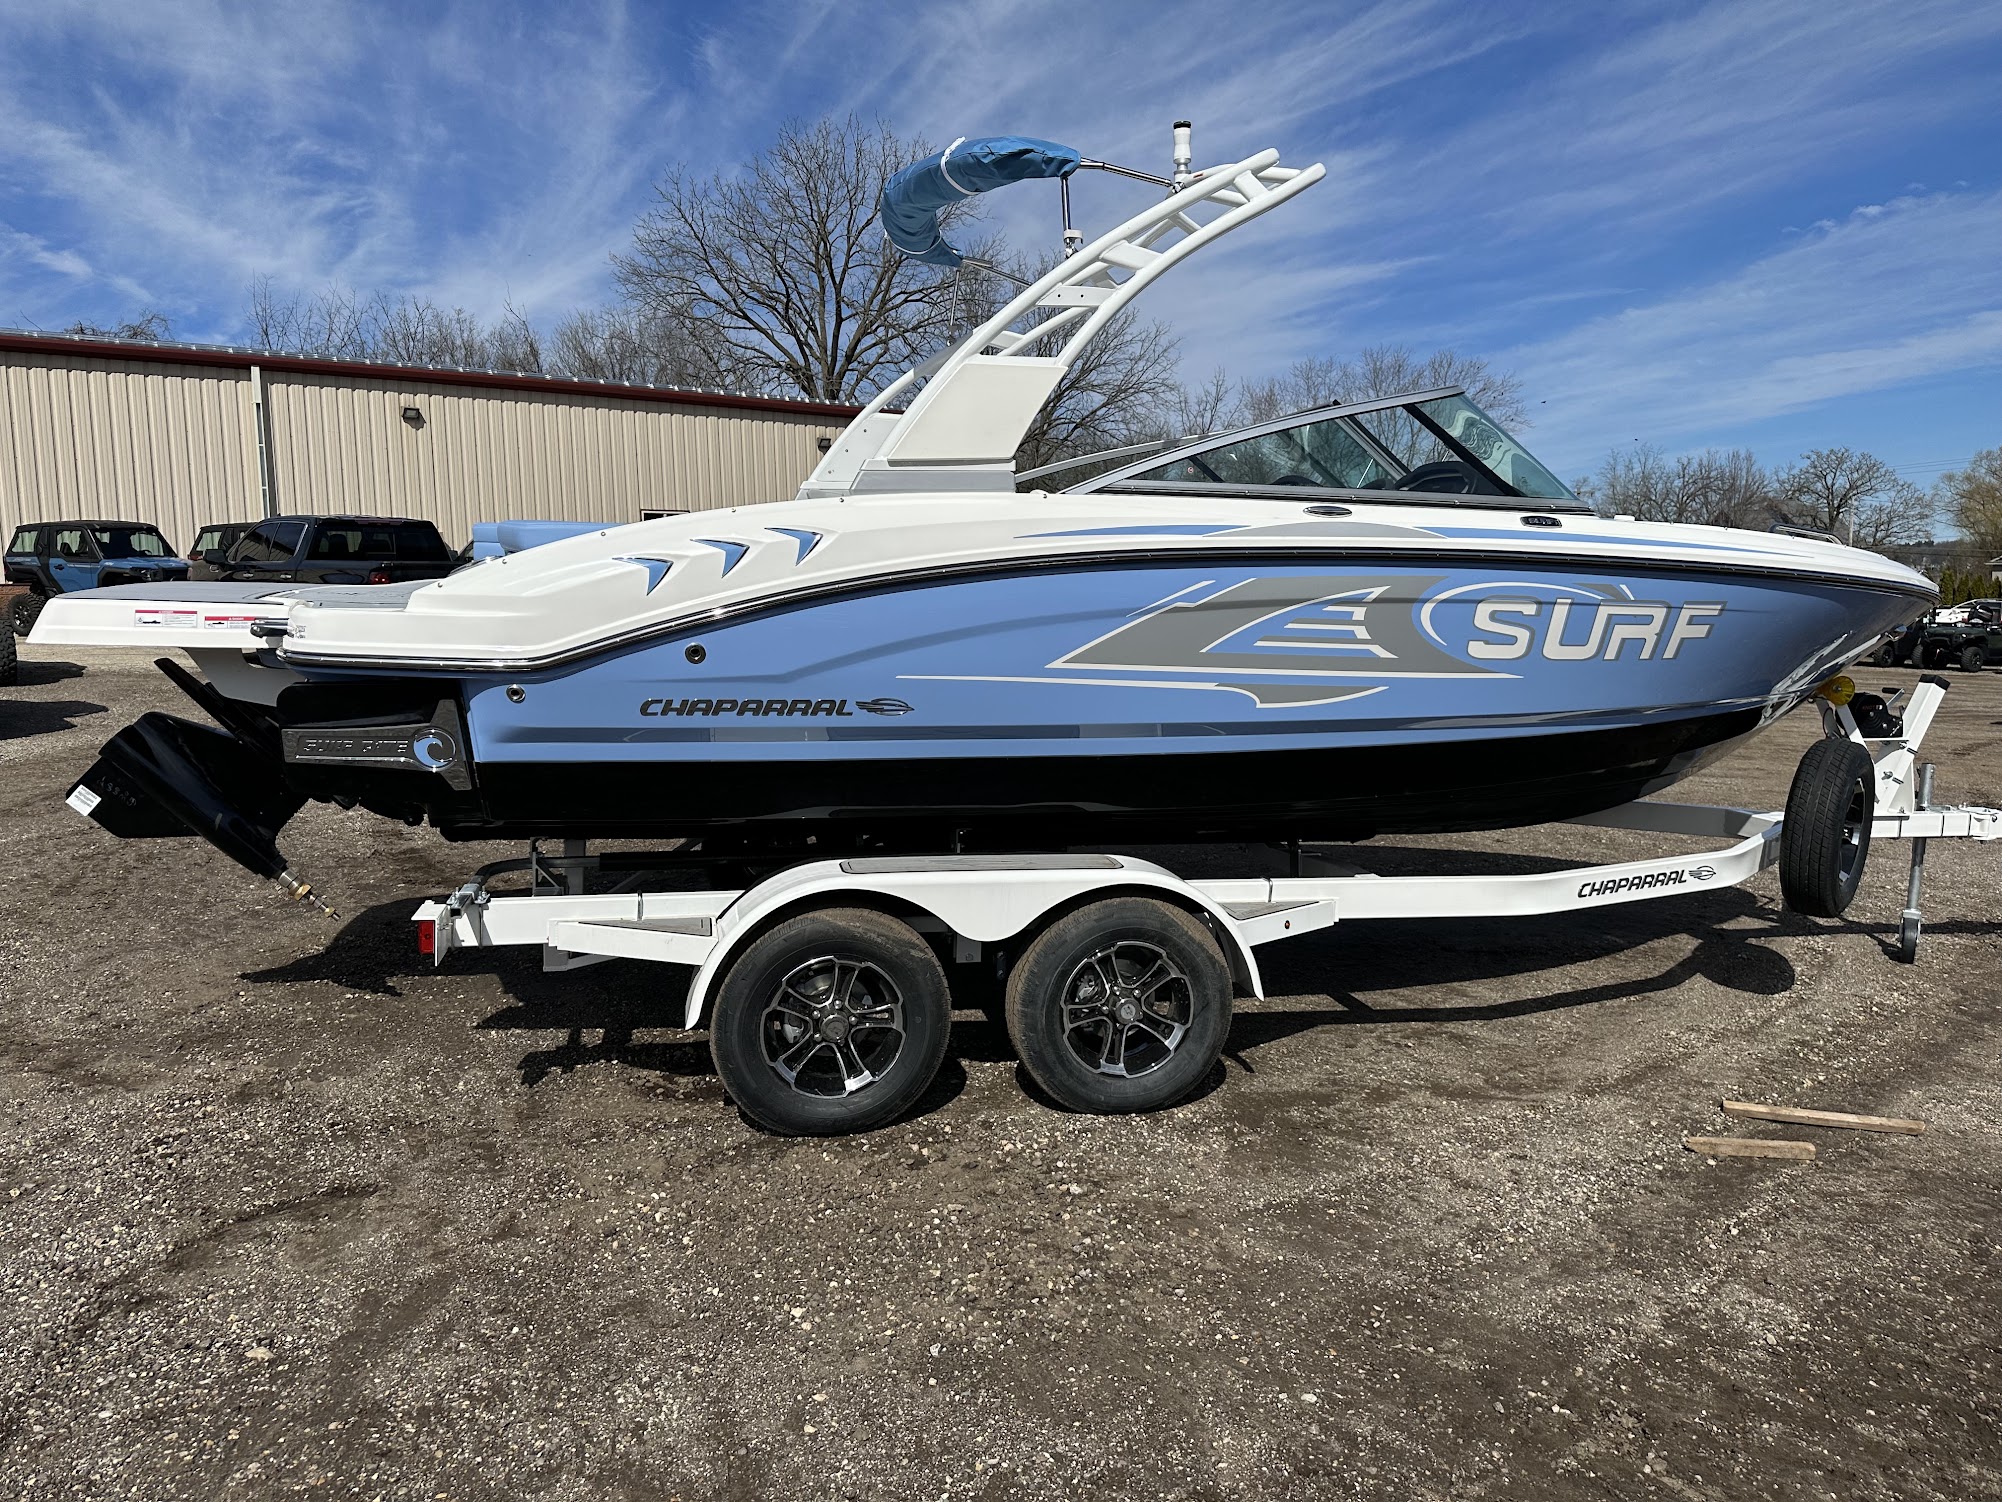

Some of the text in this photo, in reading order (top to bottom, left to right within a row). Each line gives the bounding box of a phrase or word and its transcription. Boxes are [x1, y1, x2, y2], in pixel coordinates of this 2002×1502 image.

[1467, 595, 1728, 661] SURF
[640, 698, 853, 717] CHAPARRAL
[1577, 869, 1687, 898] CHAPARRAL
